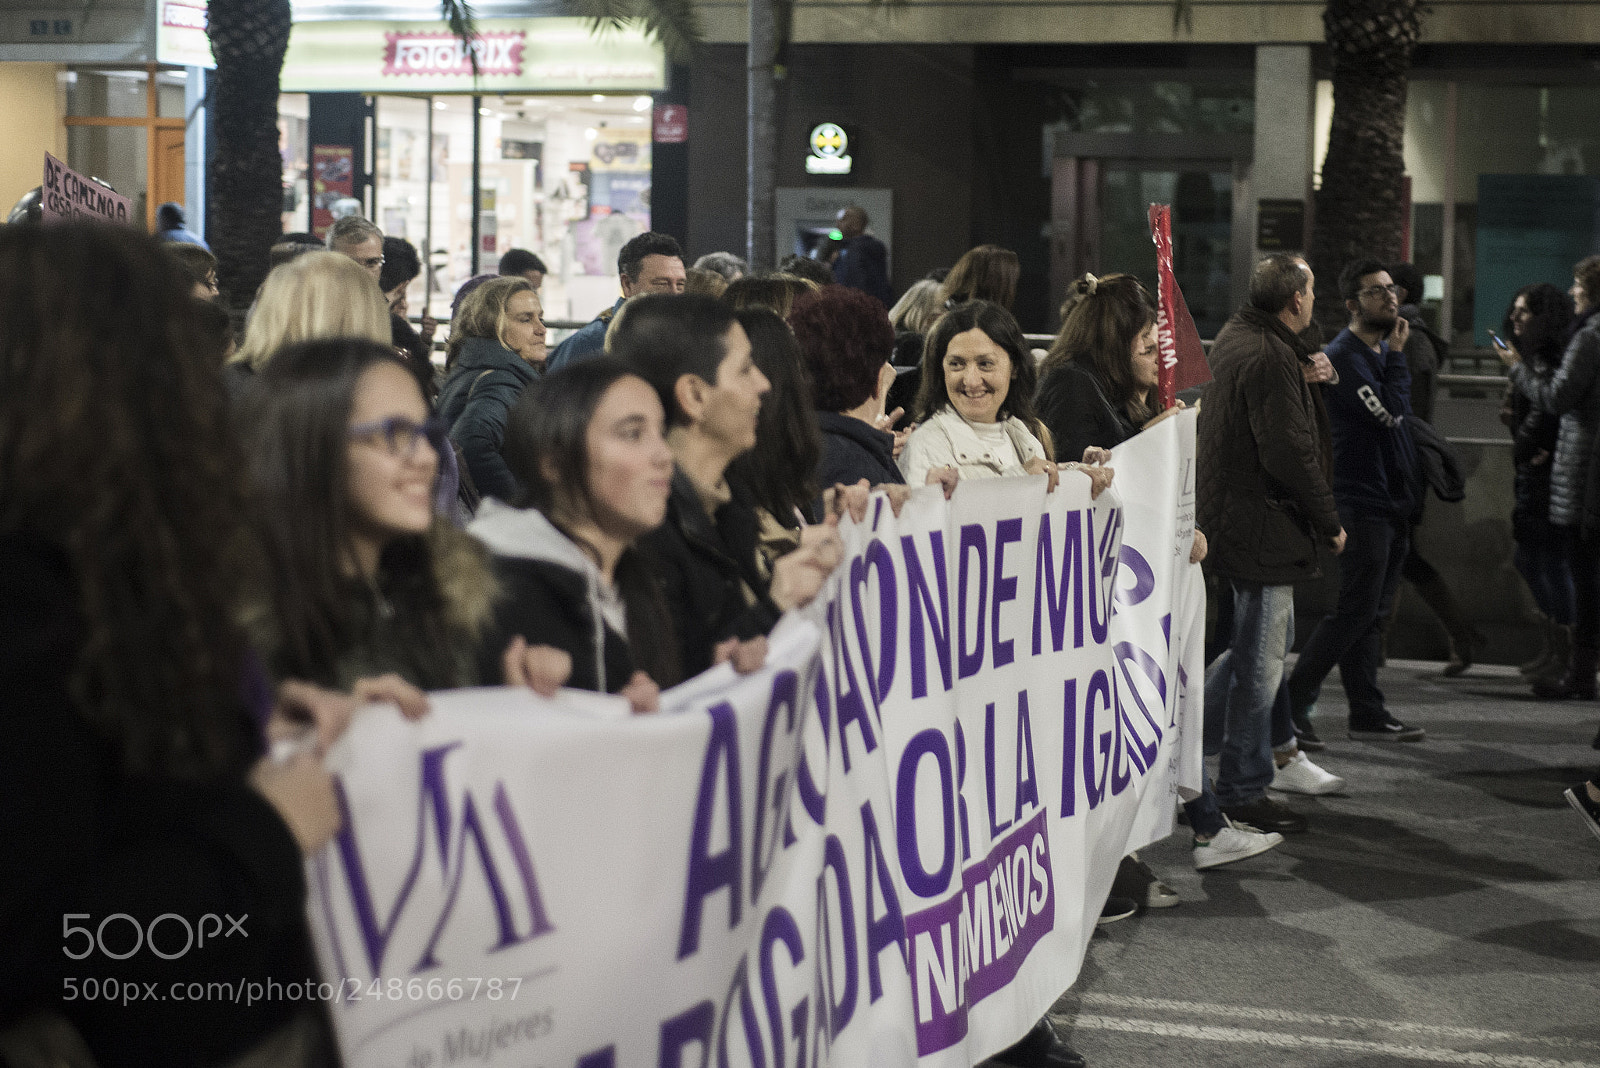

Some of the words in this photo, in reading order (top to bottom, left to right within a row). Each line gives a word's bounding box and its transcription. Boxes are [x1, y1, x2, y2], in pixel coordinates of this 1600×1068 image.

[46, 157, 61, 193] DE
[63, 172, 115, 219] CAMINO
[958, 517, 1023, 681] DE
[984, 689, 1040, 842] LA
[443, 1007, 556, 1063] Mujeres
